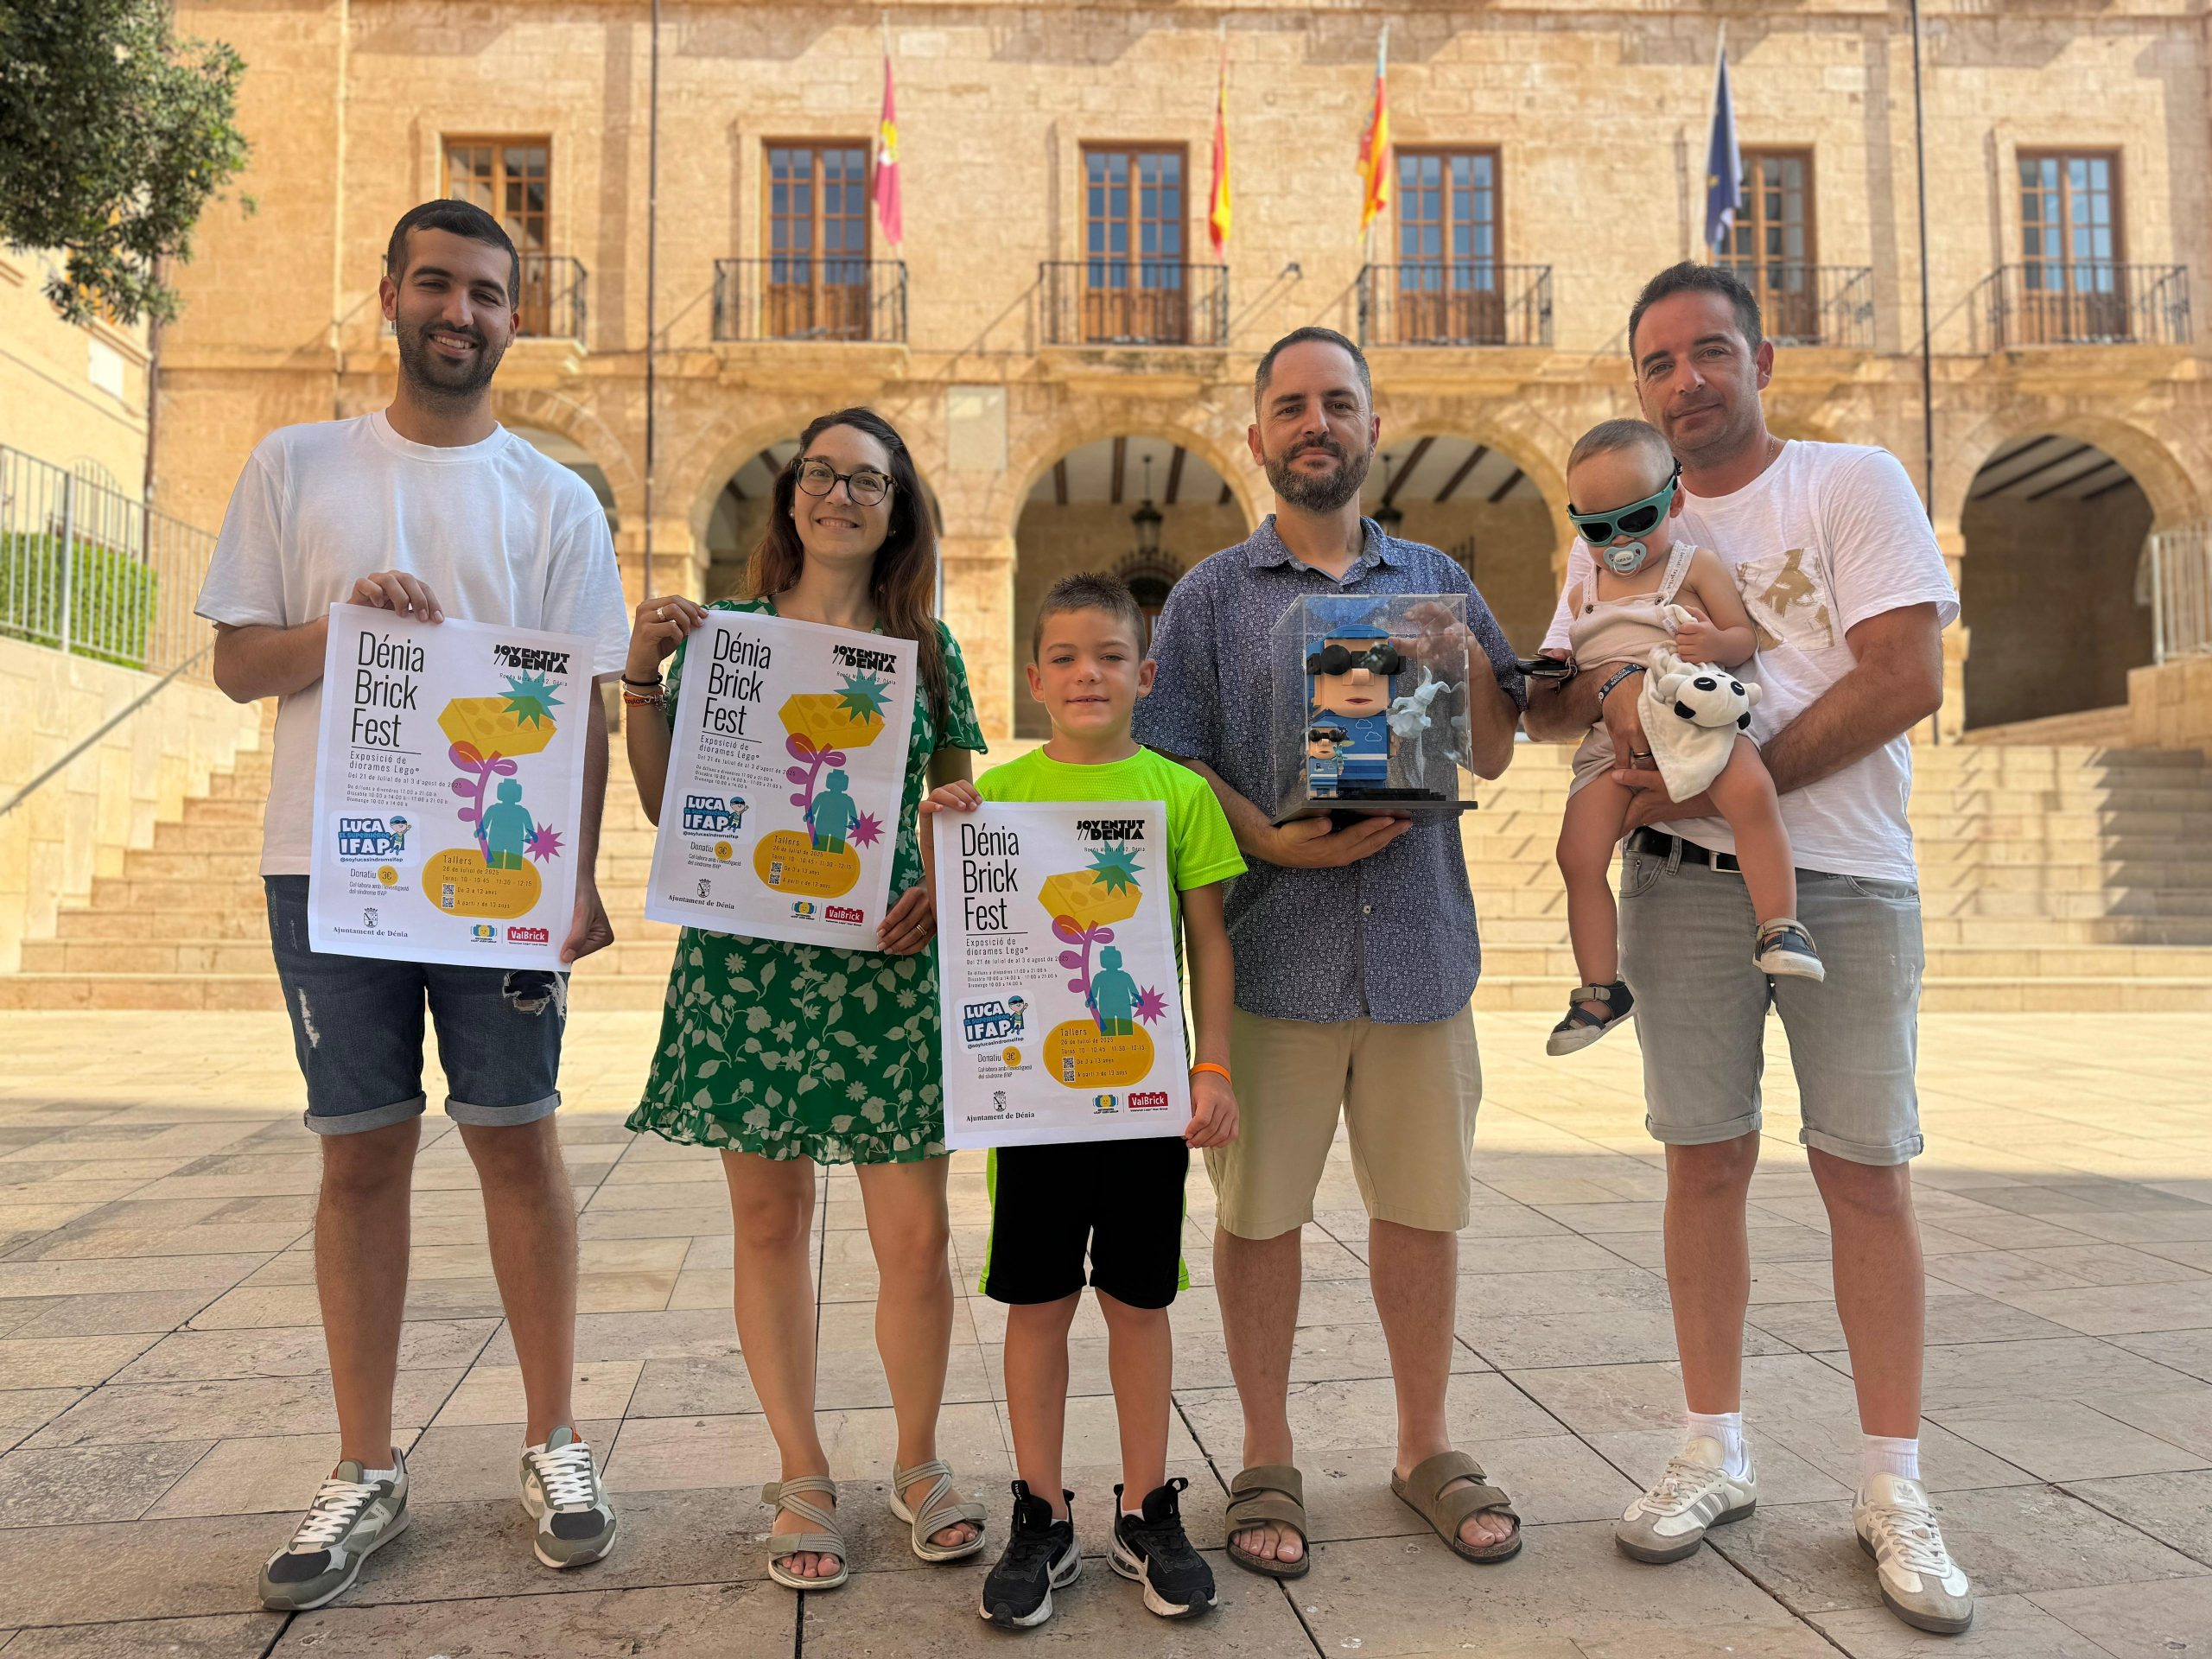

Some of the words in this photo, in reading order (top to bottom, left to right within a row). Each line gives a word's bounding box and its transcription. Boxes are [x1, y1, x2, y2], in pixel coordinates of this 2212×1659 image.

[359, 632, 424, 672] Dénia
[494, 645, 569, 663] JOVENTUT
[713, 628, 772, 670] Dénia
[833, 645, 897, 664] JOVENTUT
[709, 662, 763, 702] Brick
[355, 669, 418, 710] Brick
[702, 696, 747, 735] Fest
[352, 708, 401, 747] Fest
[700, 735, 737, 749] Exposició
[699, 744, 734, 757] diorames
[350, 751, 392, 763] Exposició
[397, 756, 406, 765] de
[349, 760, 391, 772] diorames
[688, 797, 724, 811] LUCA
[341, 819, 384, 833] LUCA
[685, 814, 729, 831] IFAP
[1077, 820, 1145, 830] JOVENTUT
[340, 838, 391, 855] IFAP
[774, 836, 800, 846] Tallers
[961, 823, 1020, 856] Dénia
[690, 842, 714, 852] Donatiu
[443, 855, 472, 864] Tallers
[351, 868, 376, 879] Donatiu
[963, 859, 1018, 893] Brick
[668, 895, 705, 906] Ajuntament
[829, 909, 860, 921] ValBrick
[964, 897, 1007, 931] Fest
[511, 931, 544, 940] ValBrick
[966, 938, 1003, 948] Exposició
[965, 1002, 1003, 1019] LUCA
[966, 1020, 1011, 1040] IFAP
[1132, 1096, 1164, 1105] ValBrick
[966, 1114, 1003, 1122] Ajuntament
